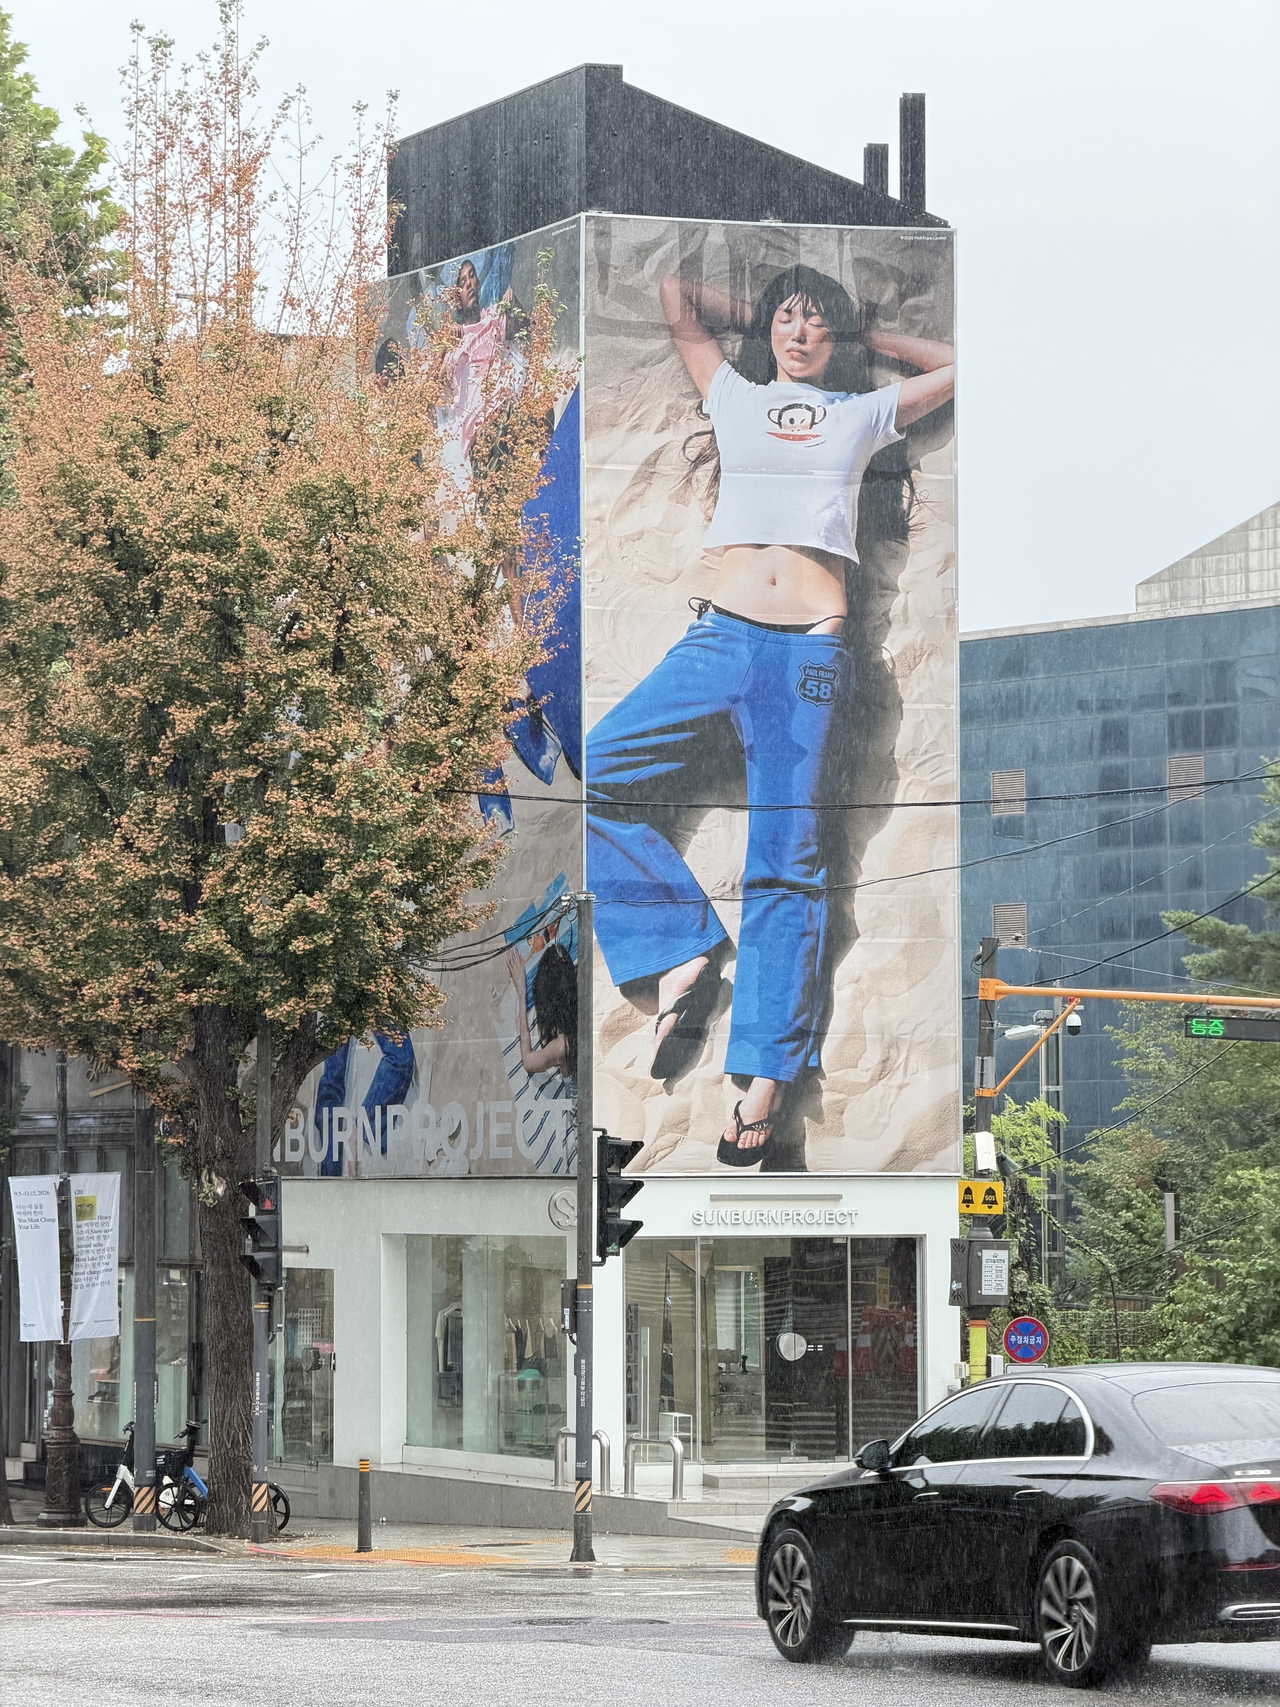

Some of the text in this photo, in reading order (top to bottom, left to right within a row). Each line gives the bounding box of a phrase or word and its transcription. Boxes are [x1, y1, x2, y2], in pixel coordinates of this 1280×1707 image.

[804, 680, 832, 699] 58
[273, 1098, 572, 1162] BURNPROJECT
[692, 1210, 858, 1226] SUNBURNPROJECT
[1010, 1335, 1042, 1345] 주정차금지
